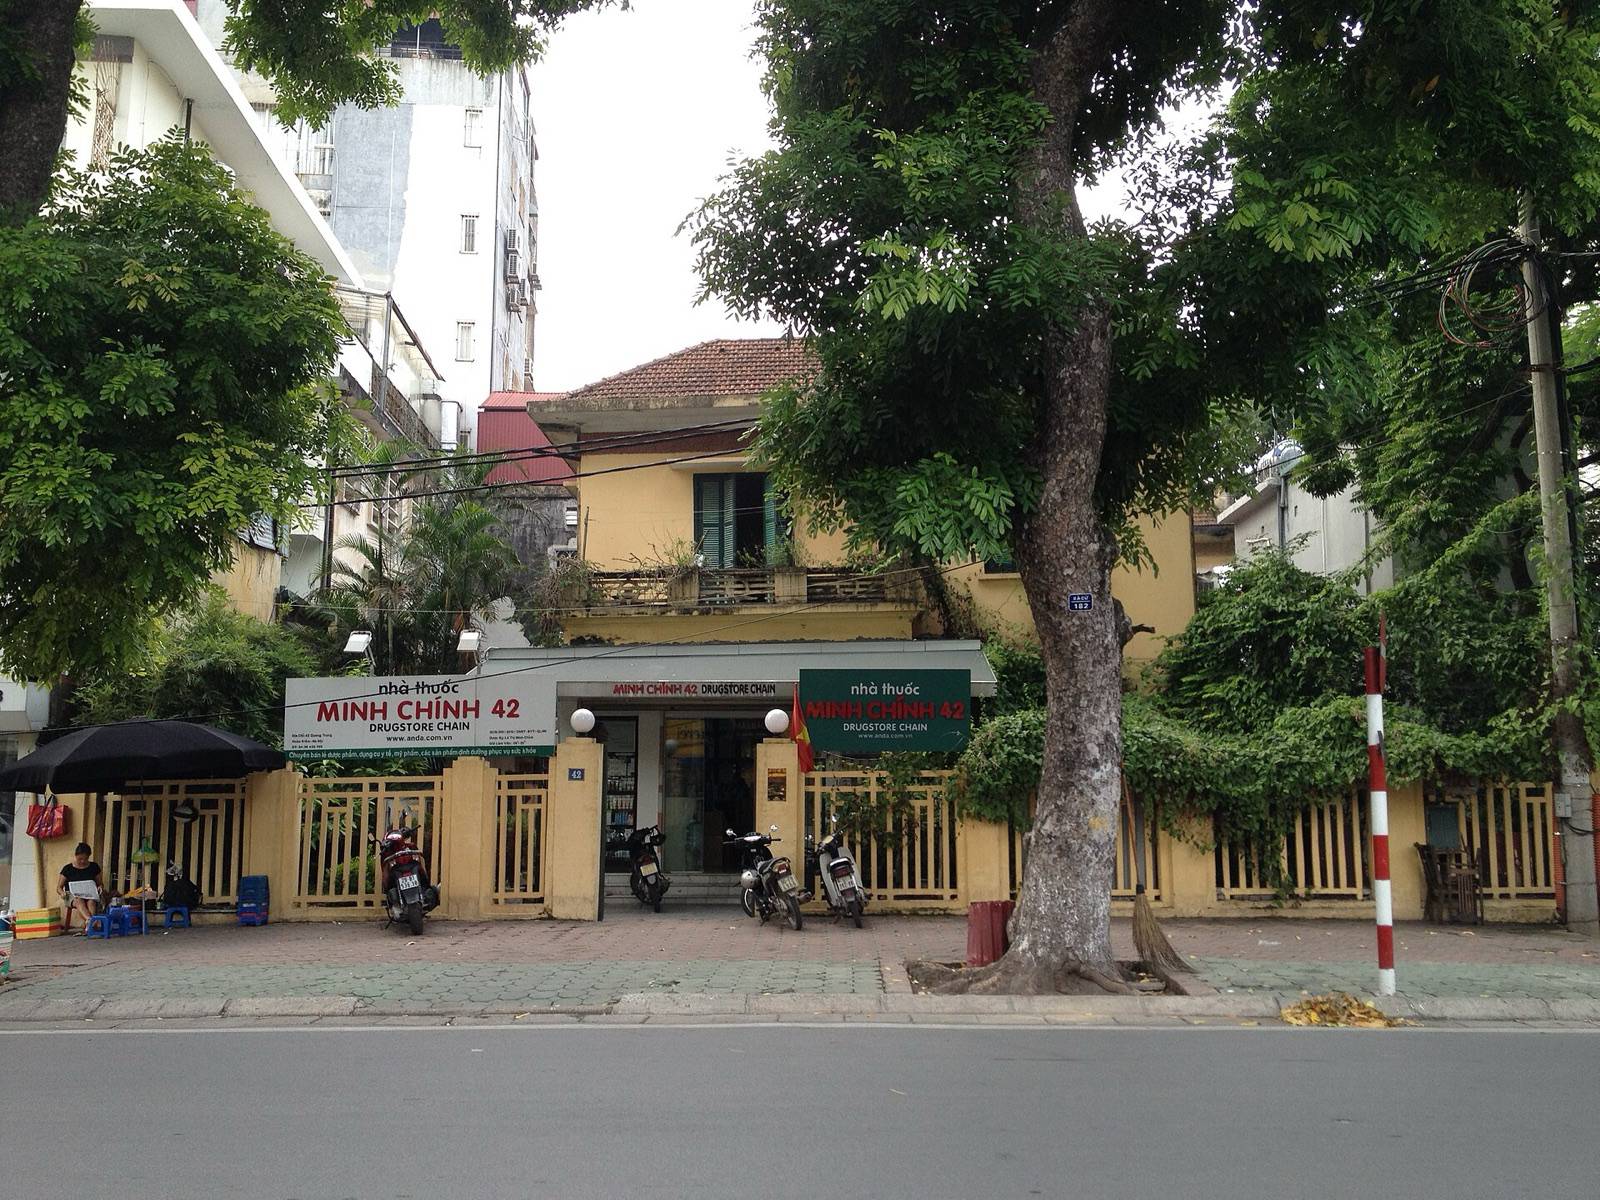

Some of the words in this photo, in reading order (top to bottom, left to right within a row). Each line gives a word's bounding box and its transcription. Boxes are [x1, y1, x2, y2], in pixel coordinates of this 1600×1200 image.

[379, 680, 409, 695] nhà
[415, 679, 459, 694] thuốc
[613, 684, 644, 694] MINH
[646, 682, 682, 694] CHÍNH
[684, 684, 698, 694] 42
[701, 684, 749, 694] DRUGSTORE
[750, 683, 776, 694] CHAIN
[851, 682, 878, 695] nhà
[882, 682, 920, 695] thuốc
[317, 701, 388, 722] MINH
[397, 696, 480, 721] CHÍNH
[491, 699, 520, 718] 42
[806, 701, 862, 719] MINH
[866, 695, 934, 719] CHÍNH
[940, 701, 965, 719] 42
[369, 722, 434, 733] DRUGSTORE
[437, 721, 470, 731] CHAIN
[843, 723, 896, 732] DRUGSTORE
[899, 723, 928, 731] CHAIN
[571, 770, 581, 779] 42
